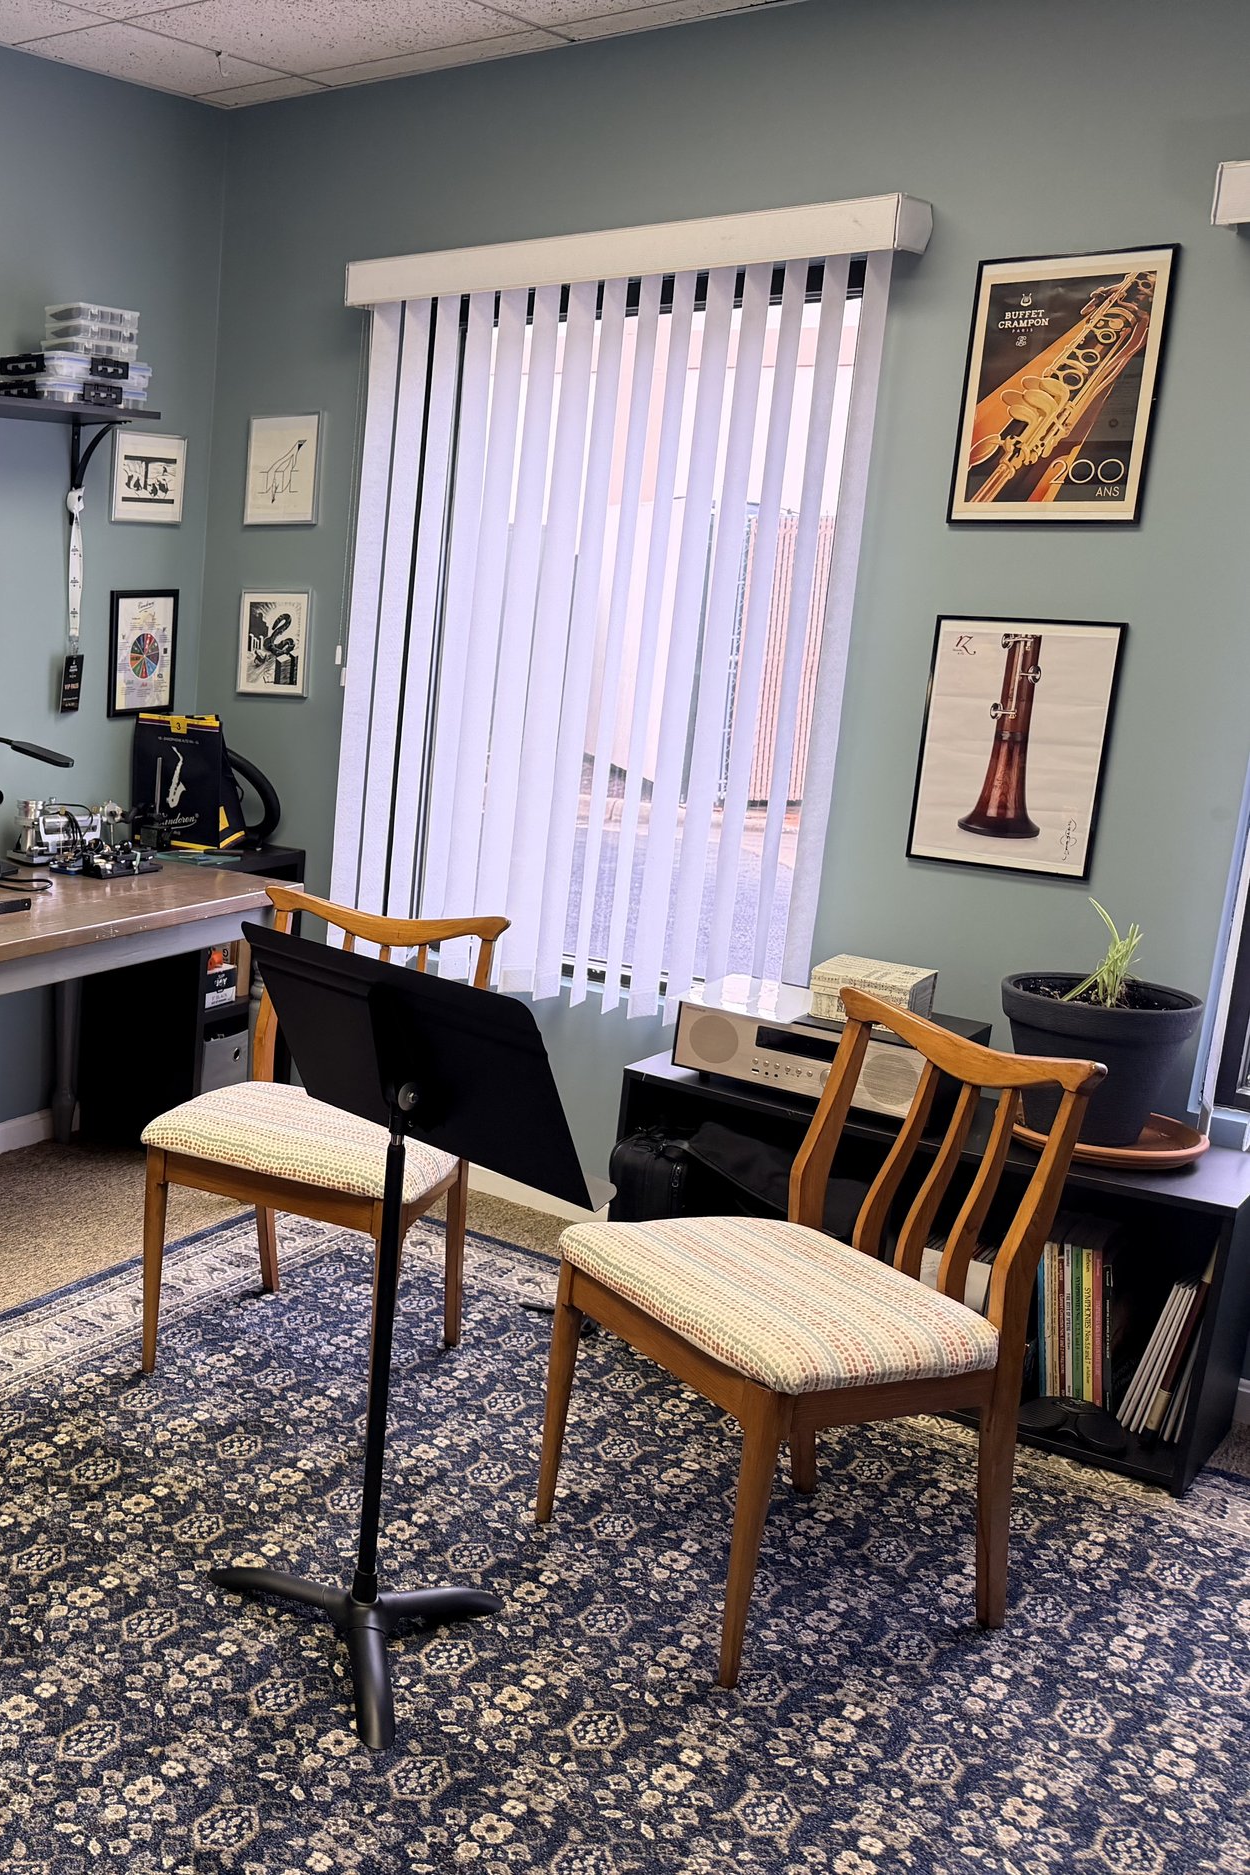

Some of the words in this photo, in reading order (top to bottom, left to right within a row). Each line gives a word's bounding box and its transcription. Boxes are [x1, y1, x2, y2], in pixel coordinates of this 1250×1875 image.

[1004, 309, 1045, 320] BUFFET
[998, 318, 1050, 329] CRAMPON
[1049, 458, 1125, 485] 200
[1095, 486, 1121, 497] ANS
[176, 722, 182, 731] 3
